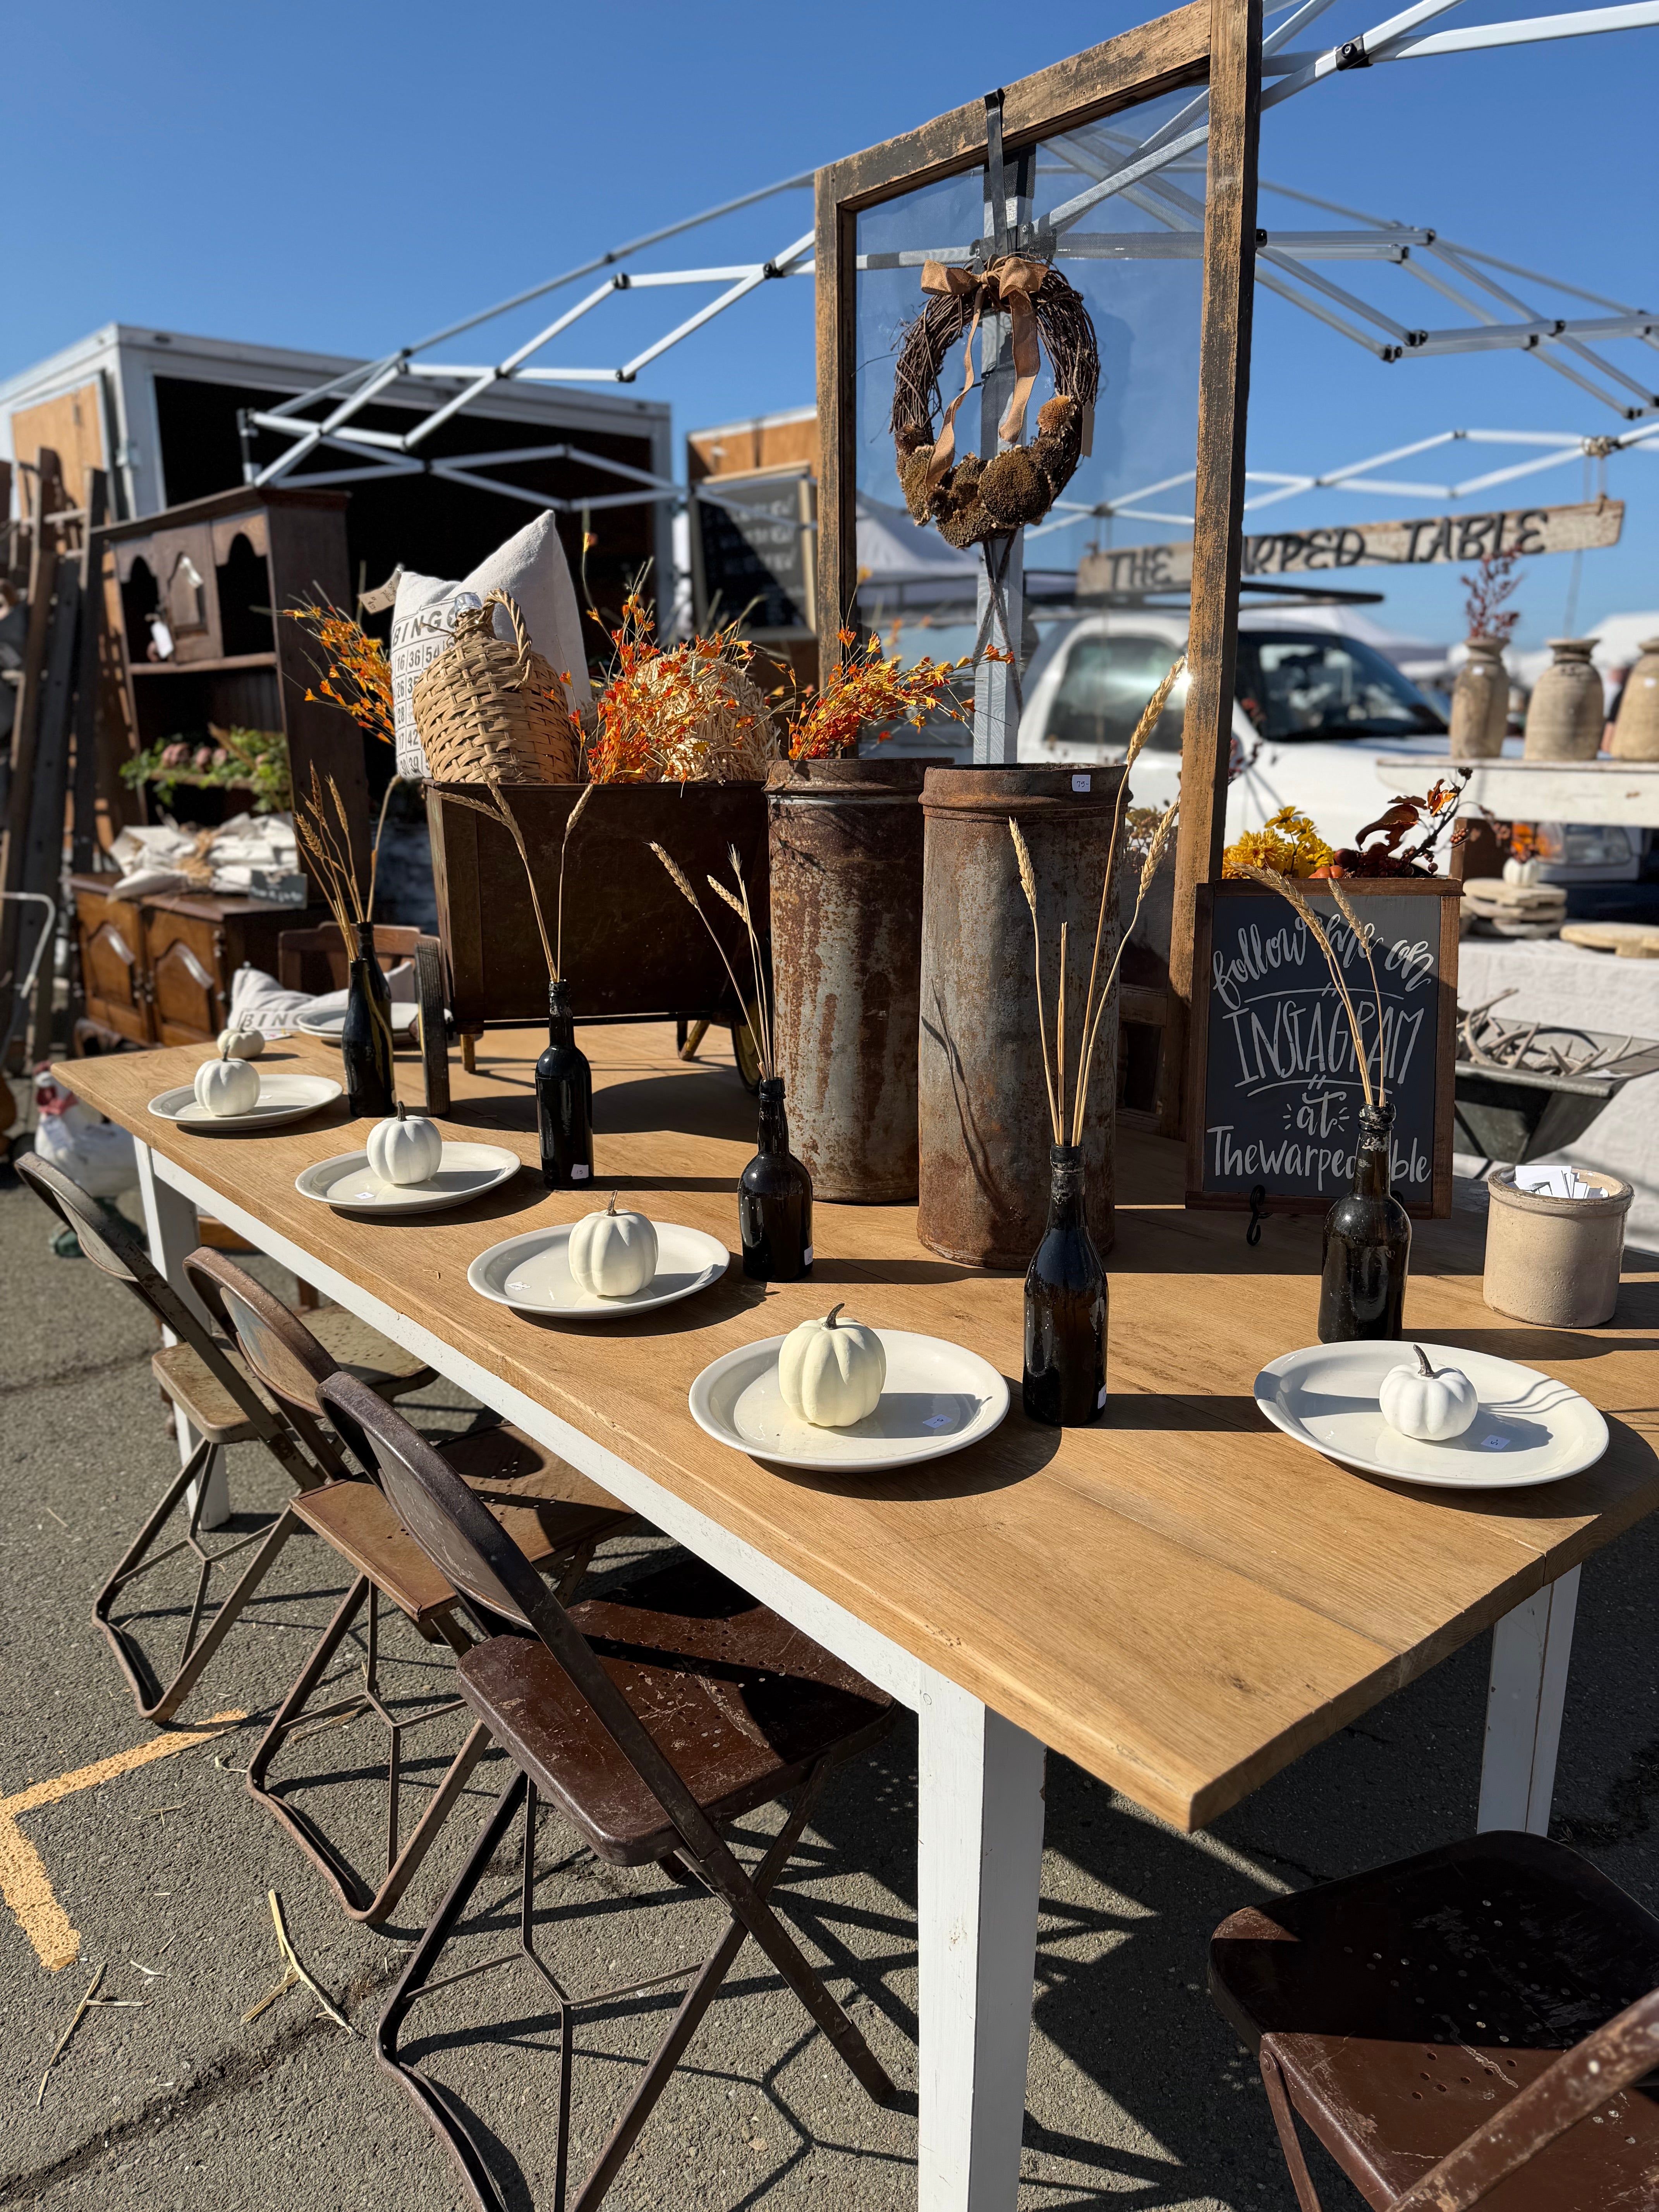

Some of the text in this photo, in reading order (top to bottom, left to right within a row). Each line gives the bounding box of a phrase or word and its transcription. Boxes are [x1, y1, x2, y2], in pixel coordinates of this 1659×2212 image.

[1107, 510, 1547, 589] THE RPED TABLE
[397, 644, 440, 672] 16 36 54
[397, 680, 404, 698] 26
[398, 706, 405, 724] 28
[399, 729, 419, 750] 17 42
[409, 756, 419, 773] 39
[1212, 916, 1323, 1010] follow
[1384, 939, 1434, 992] on
[1222, 1000, 1424, 1087] INSTAGRAM
[1297, 1090, 1347, 1139] at
